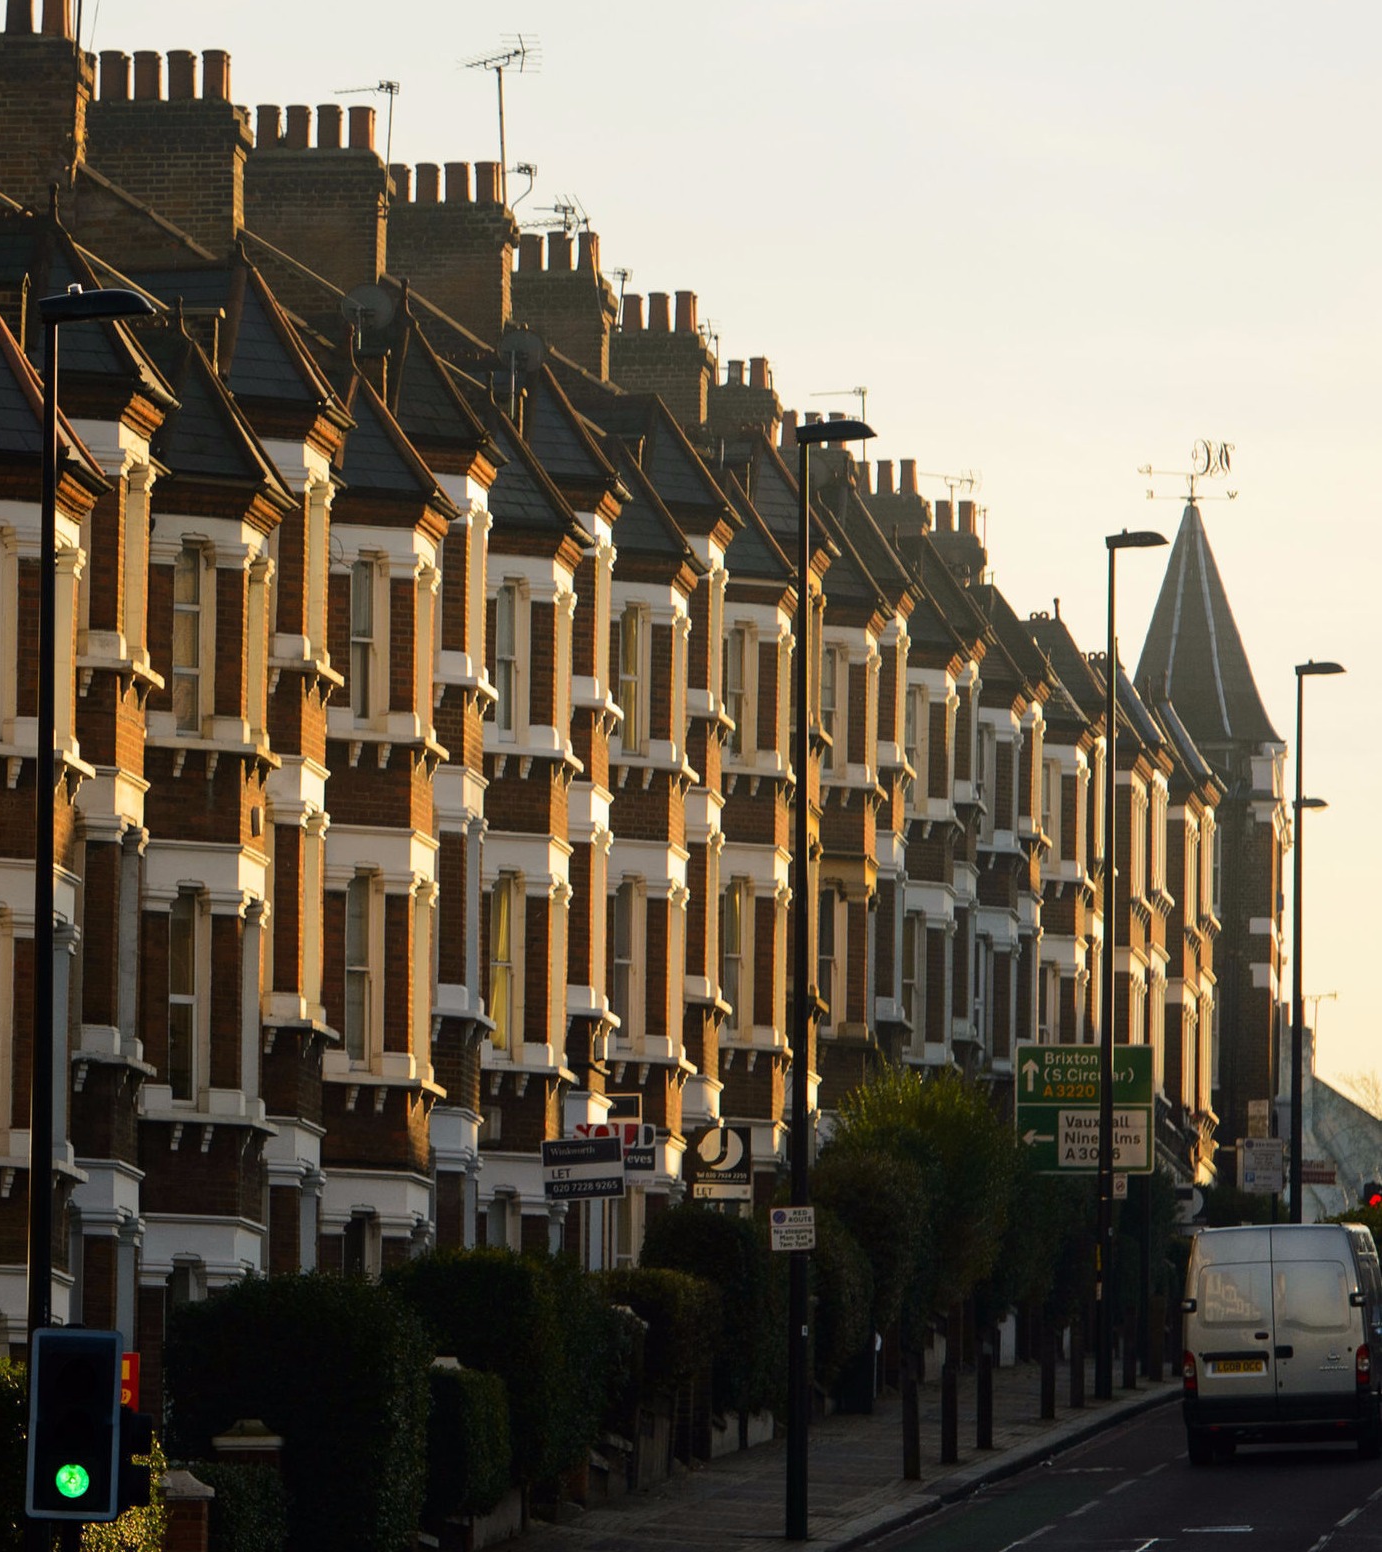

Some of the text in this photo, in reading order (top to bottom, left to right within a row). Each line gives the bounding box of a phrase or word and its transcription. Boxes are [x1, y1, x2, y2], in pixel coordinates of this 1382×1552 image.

[1044, 1051, 1098, 1065] Brixton
[1065, 1115, 1130, 1128] Vauxall
[574, 1123, 656, 1149] SOLD
[1065, 1131, 1141, 1144] Nine lms
[549, 1145, 596, 1157] Winkworth
[1065, 1147, 1121, 1160] A306
[552, 1168, 571, 1180] LET
[553, 1184, 570, 1193] 020
[571, 1182, 594, 1191] 7228
[595, 1180, 618, 1190] 9265
[696, 1187, 713, 1196] LET
